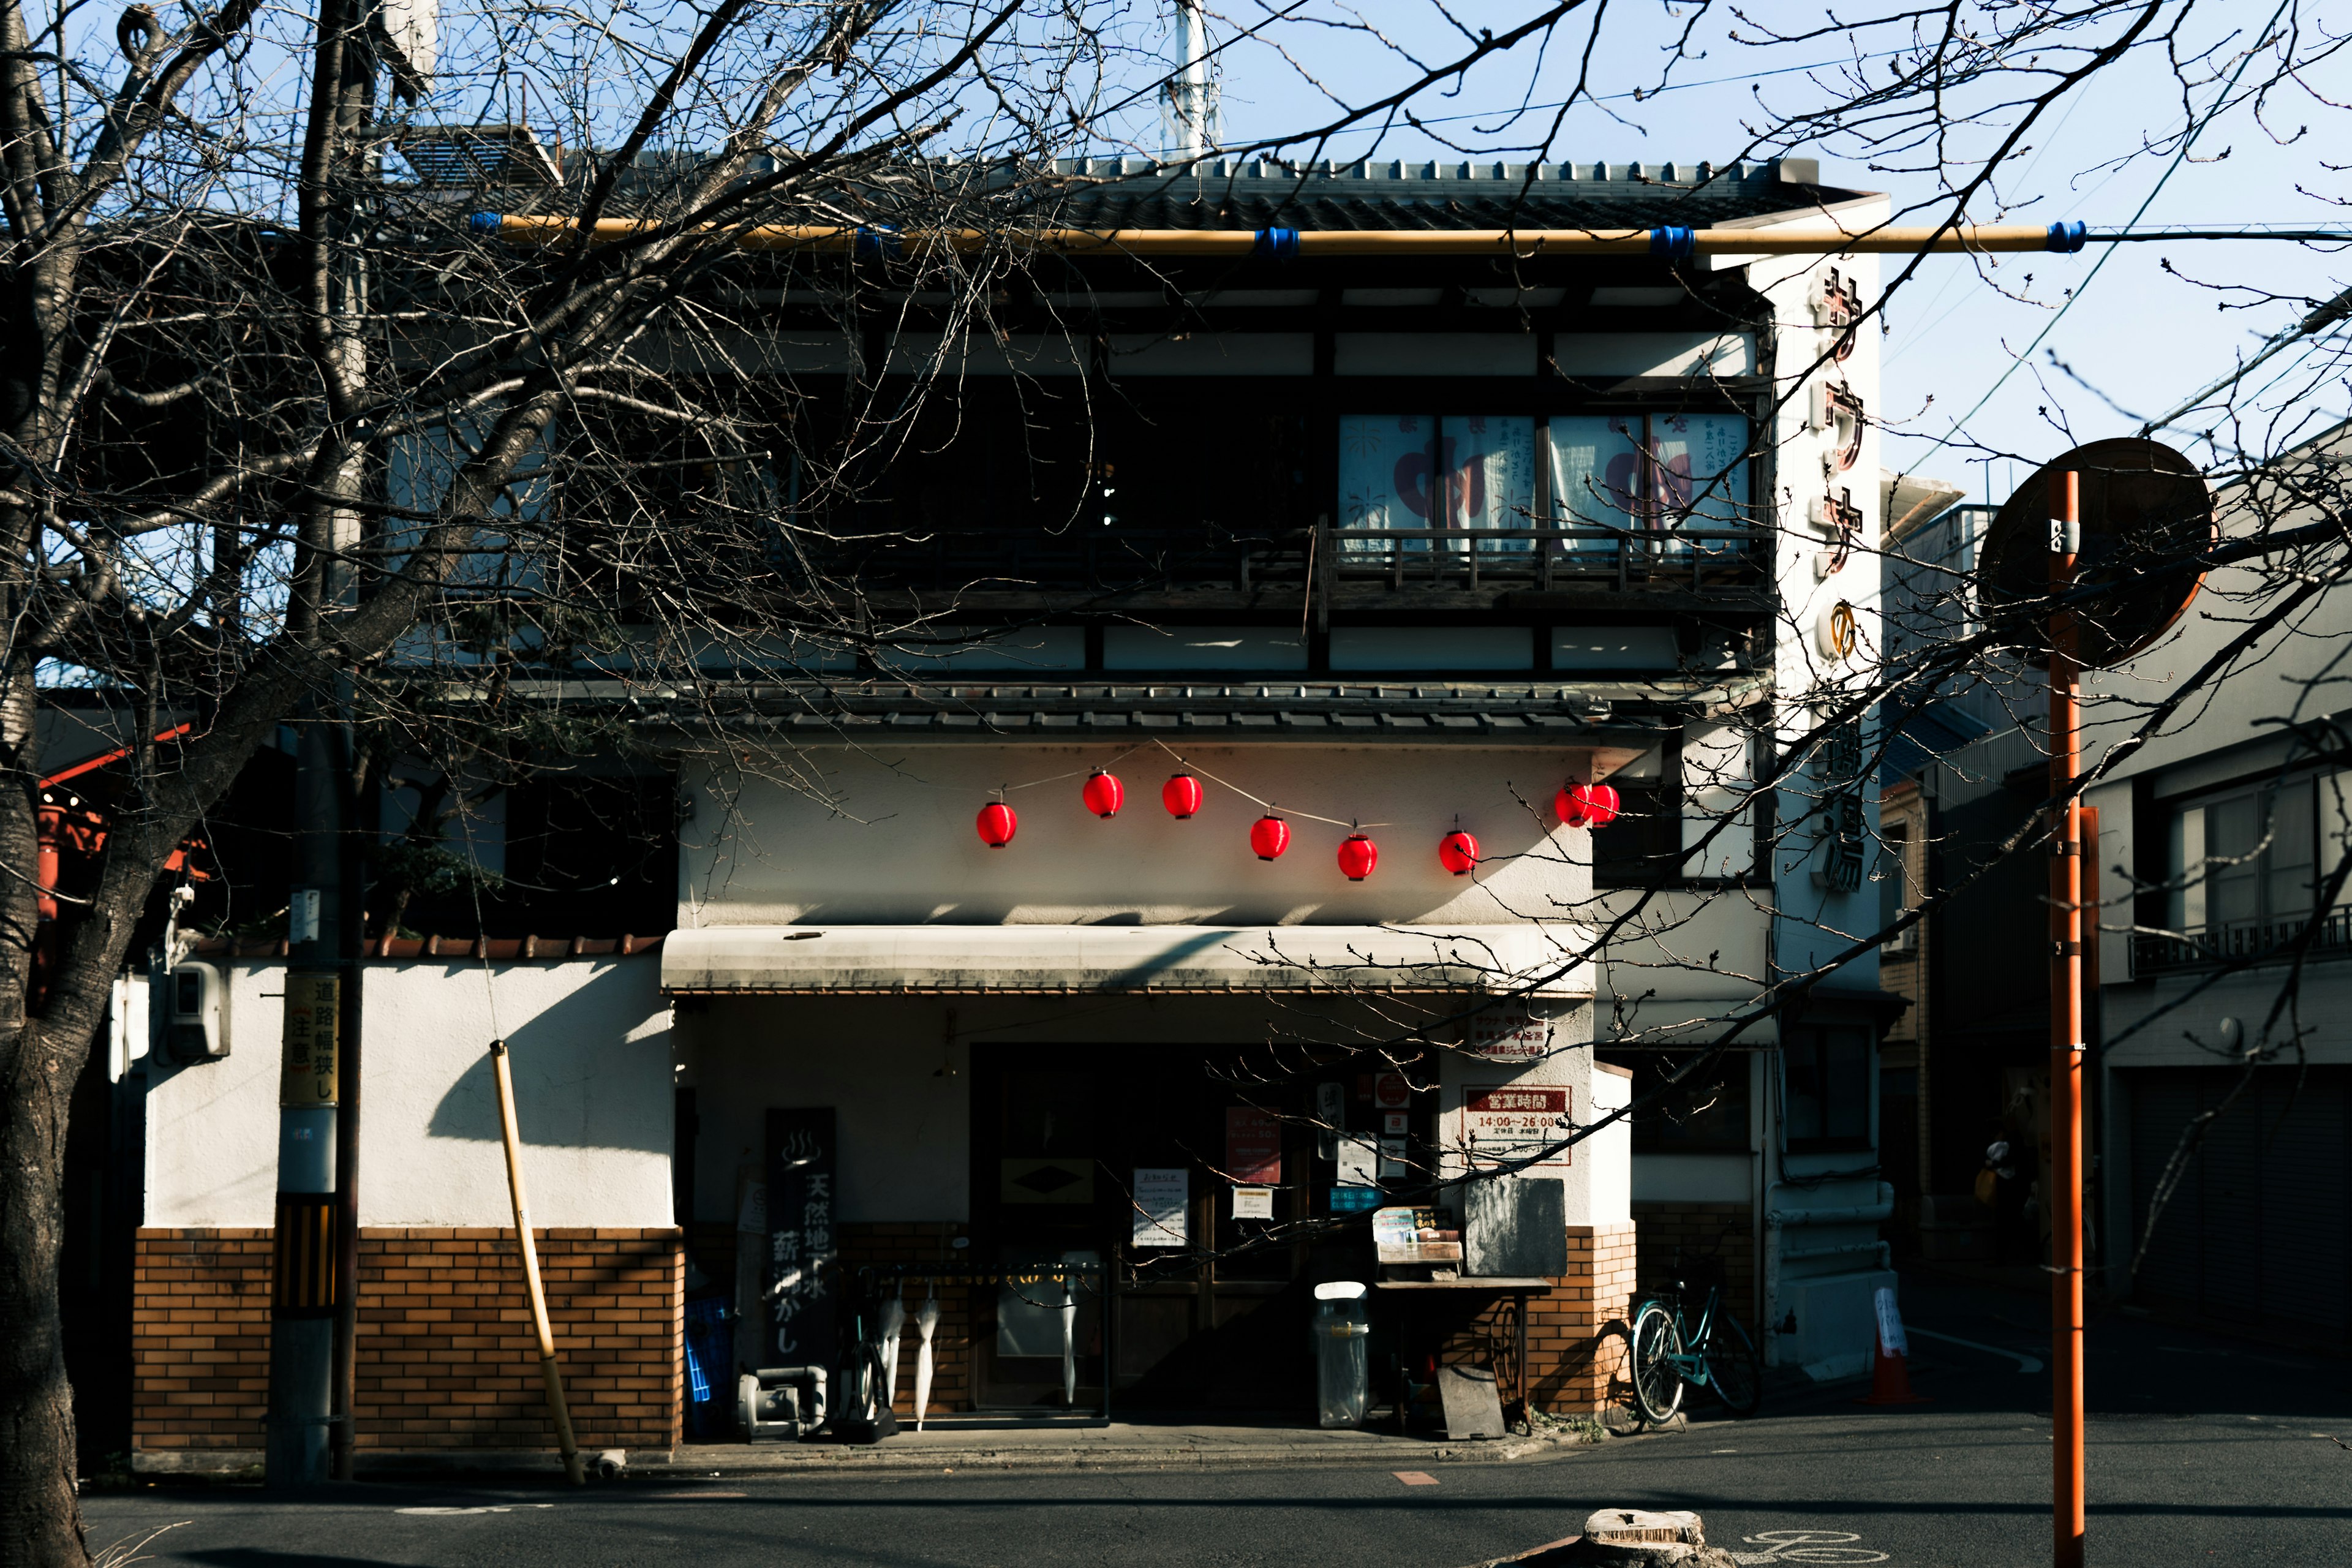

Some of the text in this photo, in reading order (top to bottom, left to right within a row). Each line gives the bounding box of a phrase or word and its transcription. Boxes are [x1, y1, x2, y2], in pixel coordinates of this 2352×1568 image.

[291, 1017, 311, 1064] 注意
[314, 981, 334, 1099] 道路幅狭し
[1476, 1016, 1501, 1025] サウナ
[1488, 1093, 1547, 1109] 営業時間
[804, 1174, 830, 1300] 天然地下水
